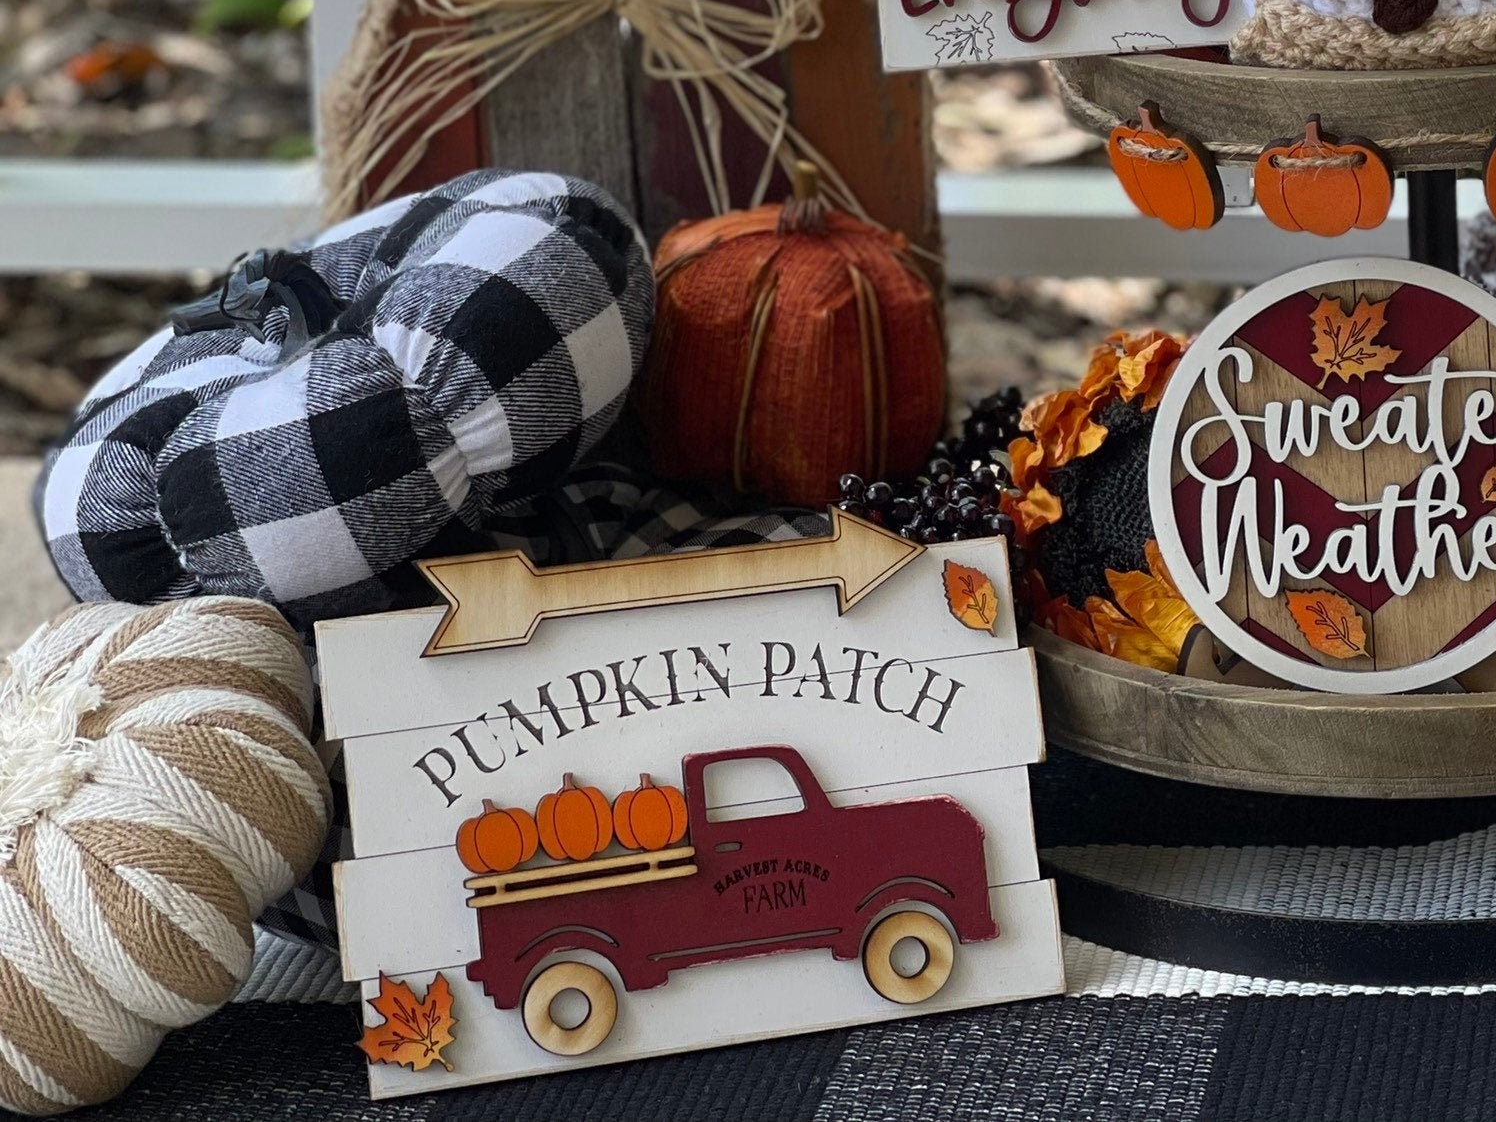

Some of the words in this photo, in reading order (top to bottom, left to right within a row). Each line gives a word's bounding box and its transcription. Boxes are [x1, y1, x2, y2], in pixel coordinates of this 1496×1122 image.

[412, 643, 734, 808] PUMPKIN
[761, 641, 965, 735] PATCH
[714, 859, 778, 895] HARVEST
[784, 859, 830, 882] ACRES
[743, 879, 807, 913] FARM
